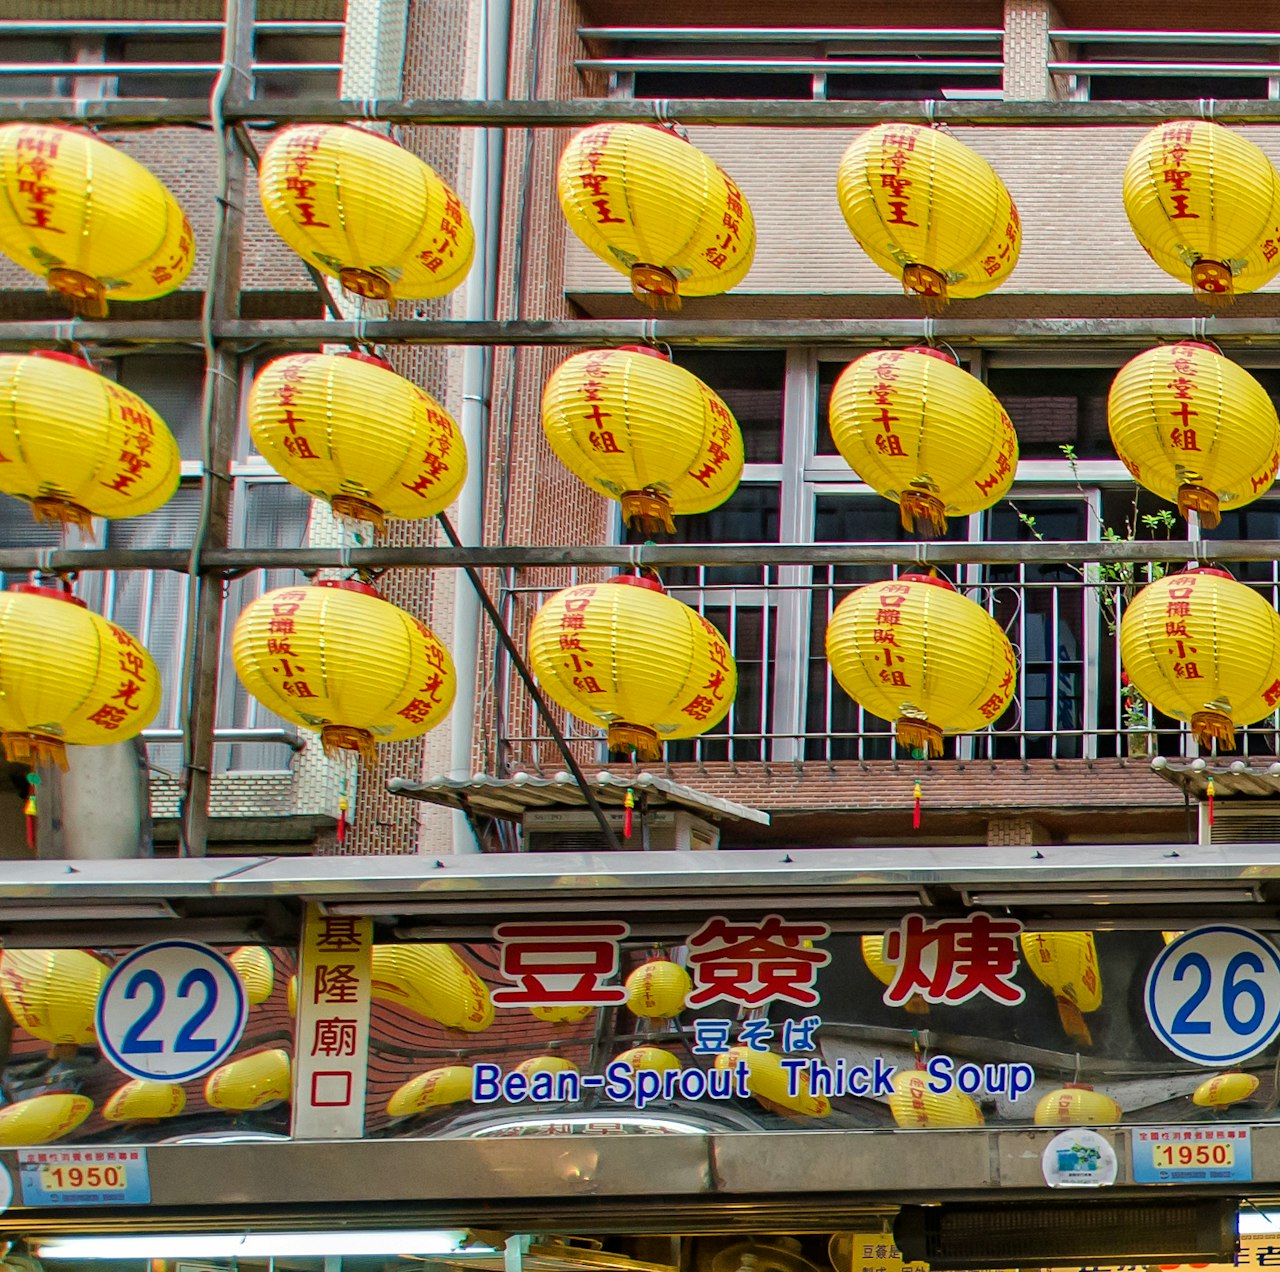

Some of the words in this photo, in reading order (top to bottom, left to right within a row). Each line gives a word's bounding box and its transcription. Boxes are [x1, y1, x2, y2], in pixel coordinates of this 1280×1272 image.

[287, 141, 329, 229] 開漳聖王
[580, 137, 626, 225] 開漳聖王
[882, 136, 920, 228] 開漳聖王
[1159, 124, 1200, 221] 開漳聖王
[120, 967, 219, 1055] 22
[310, 915, 363, 1109] 基隆廟口
[695, 1018, 822, 1054] 豆そば
[1172, 952, 1265, 1036] 26
[475, 1063, 749, 1107] Bean-Sprout
[782, 1058, 895, 1097] Thick
[928, 1057, 1034, 1101] Soup
[52, 1167, 118, 1187] 1950
[1163, 1146, 1226, 1165] 1950
